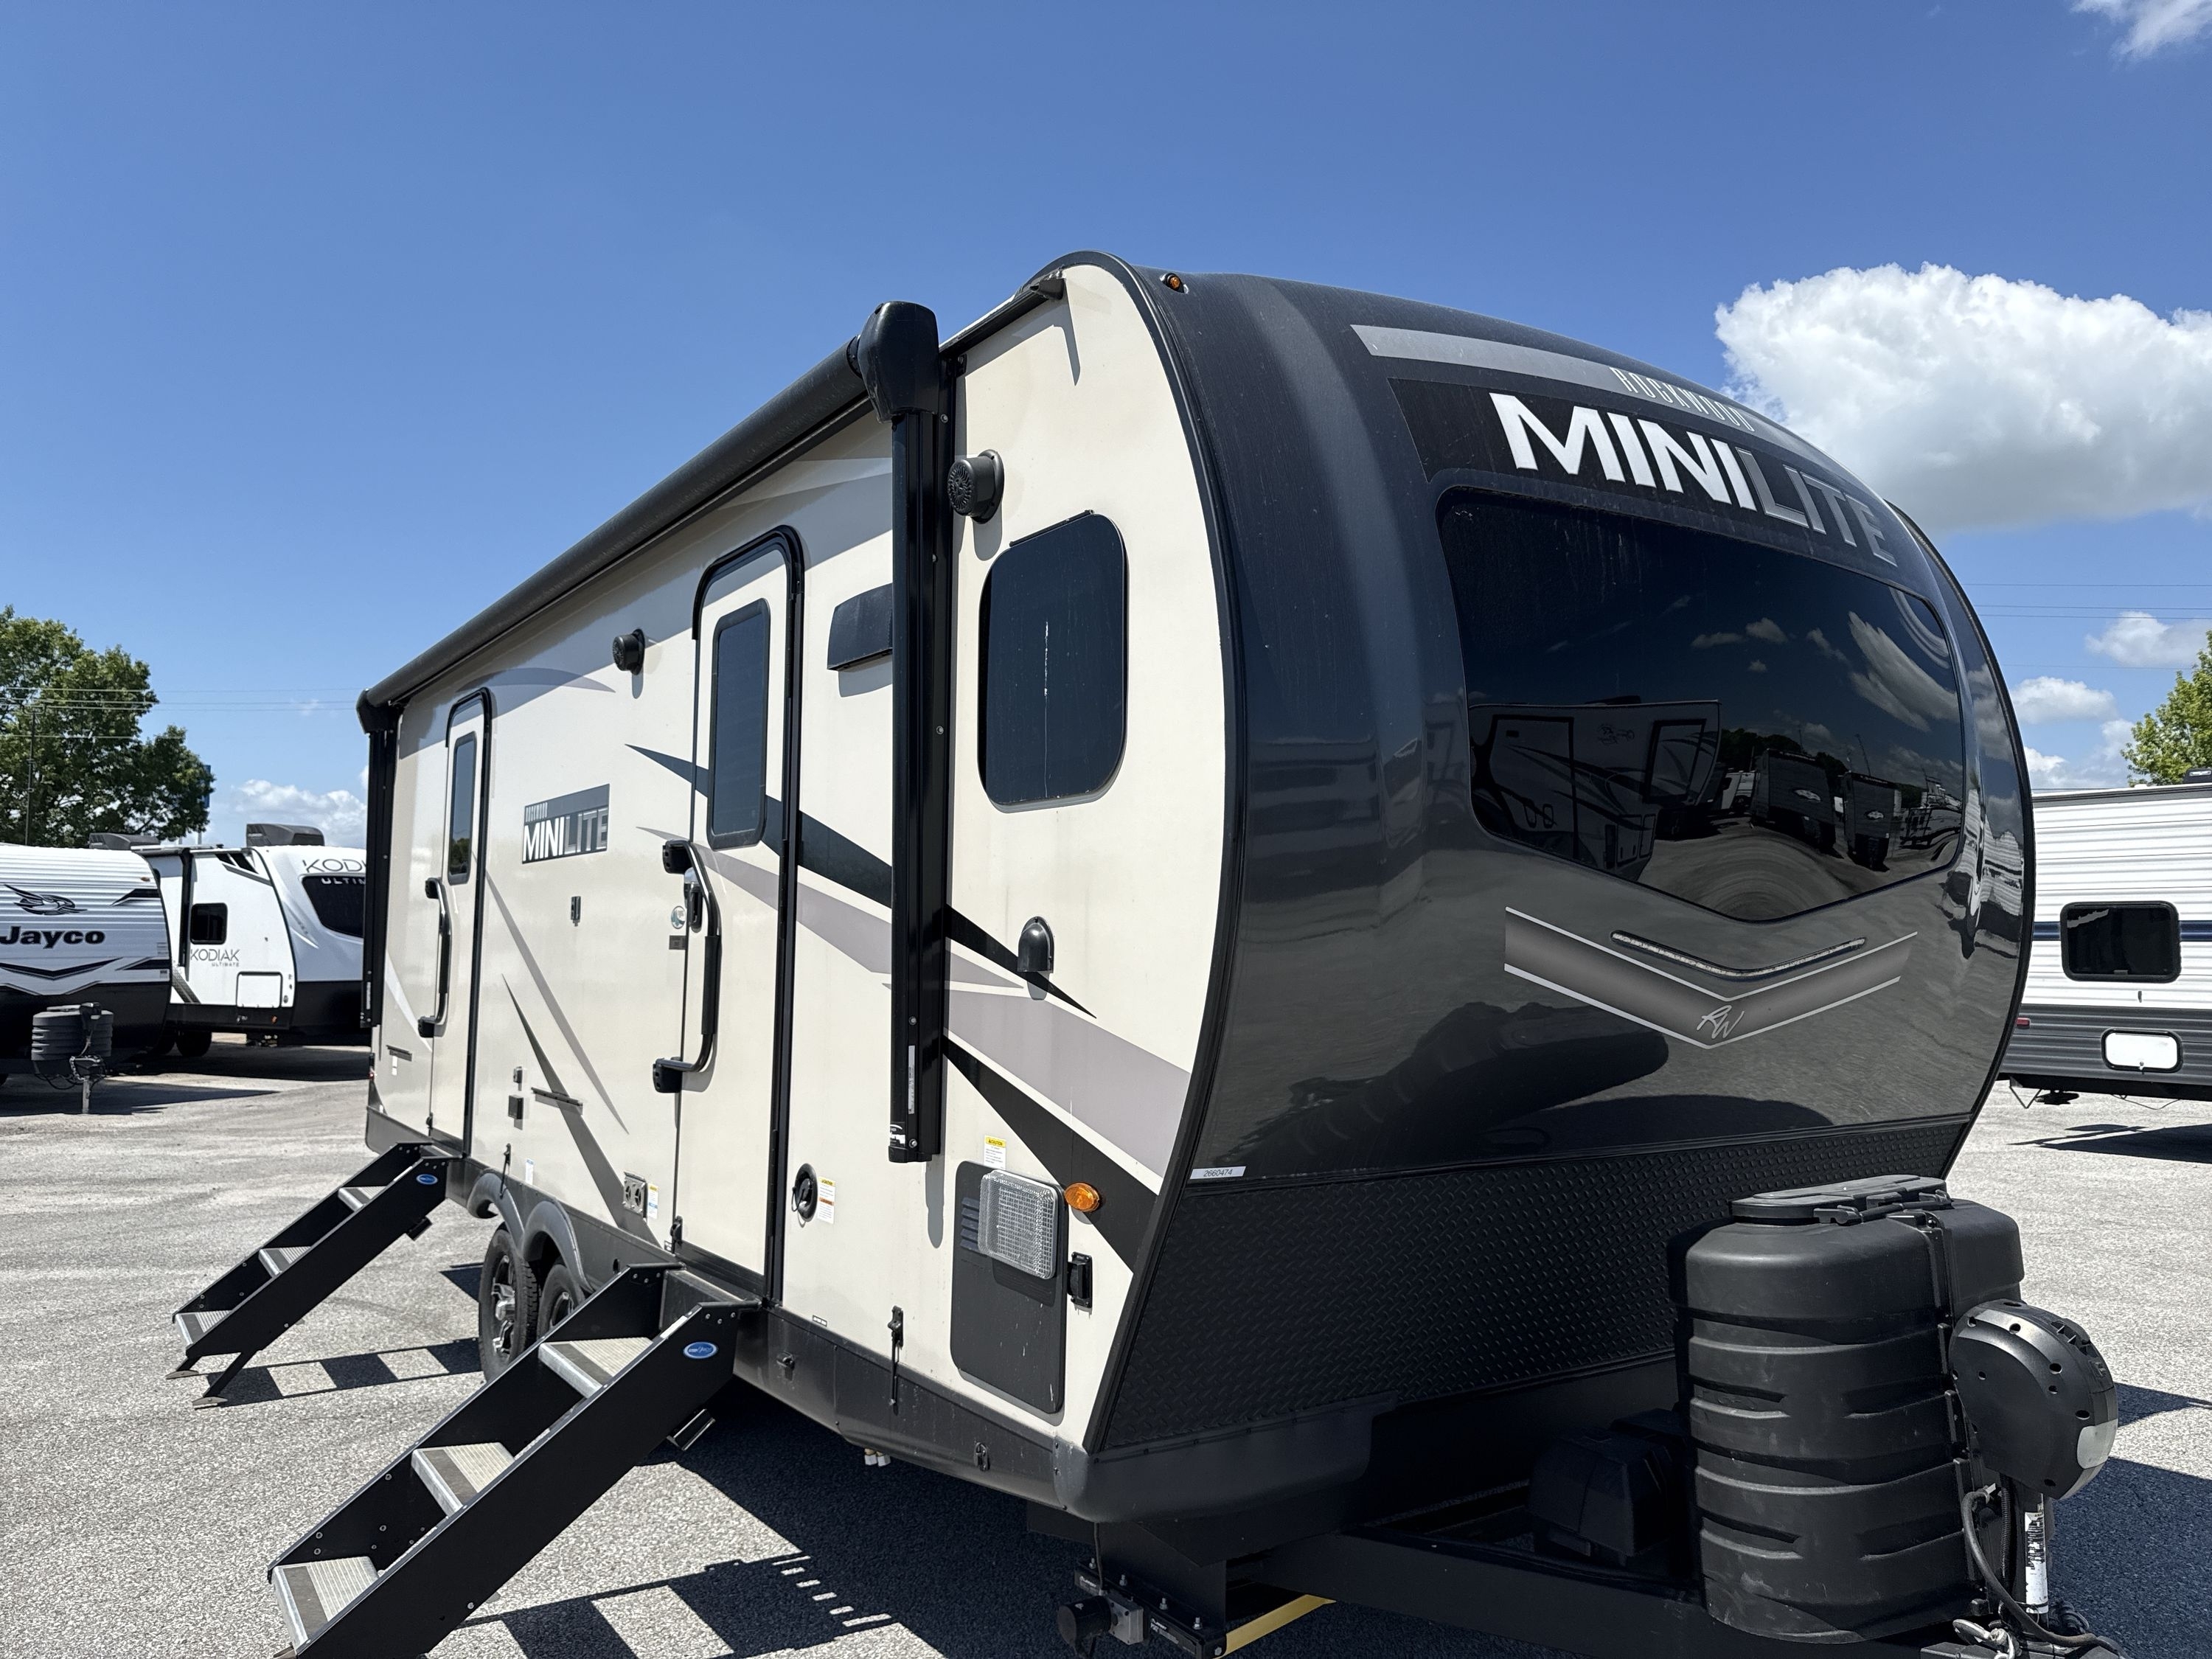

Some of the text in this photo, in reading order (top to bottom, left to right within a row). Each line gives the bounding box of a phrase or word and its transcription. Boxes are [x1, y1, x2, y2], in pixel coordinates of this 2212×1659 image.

[1609, 367, 1755, 432] ROCKWOOD
[0, 925, 105, 949] Jayco
[190, 948, 240, 961] KODIAK
